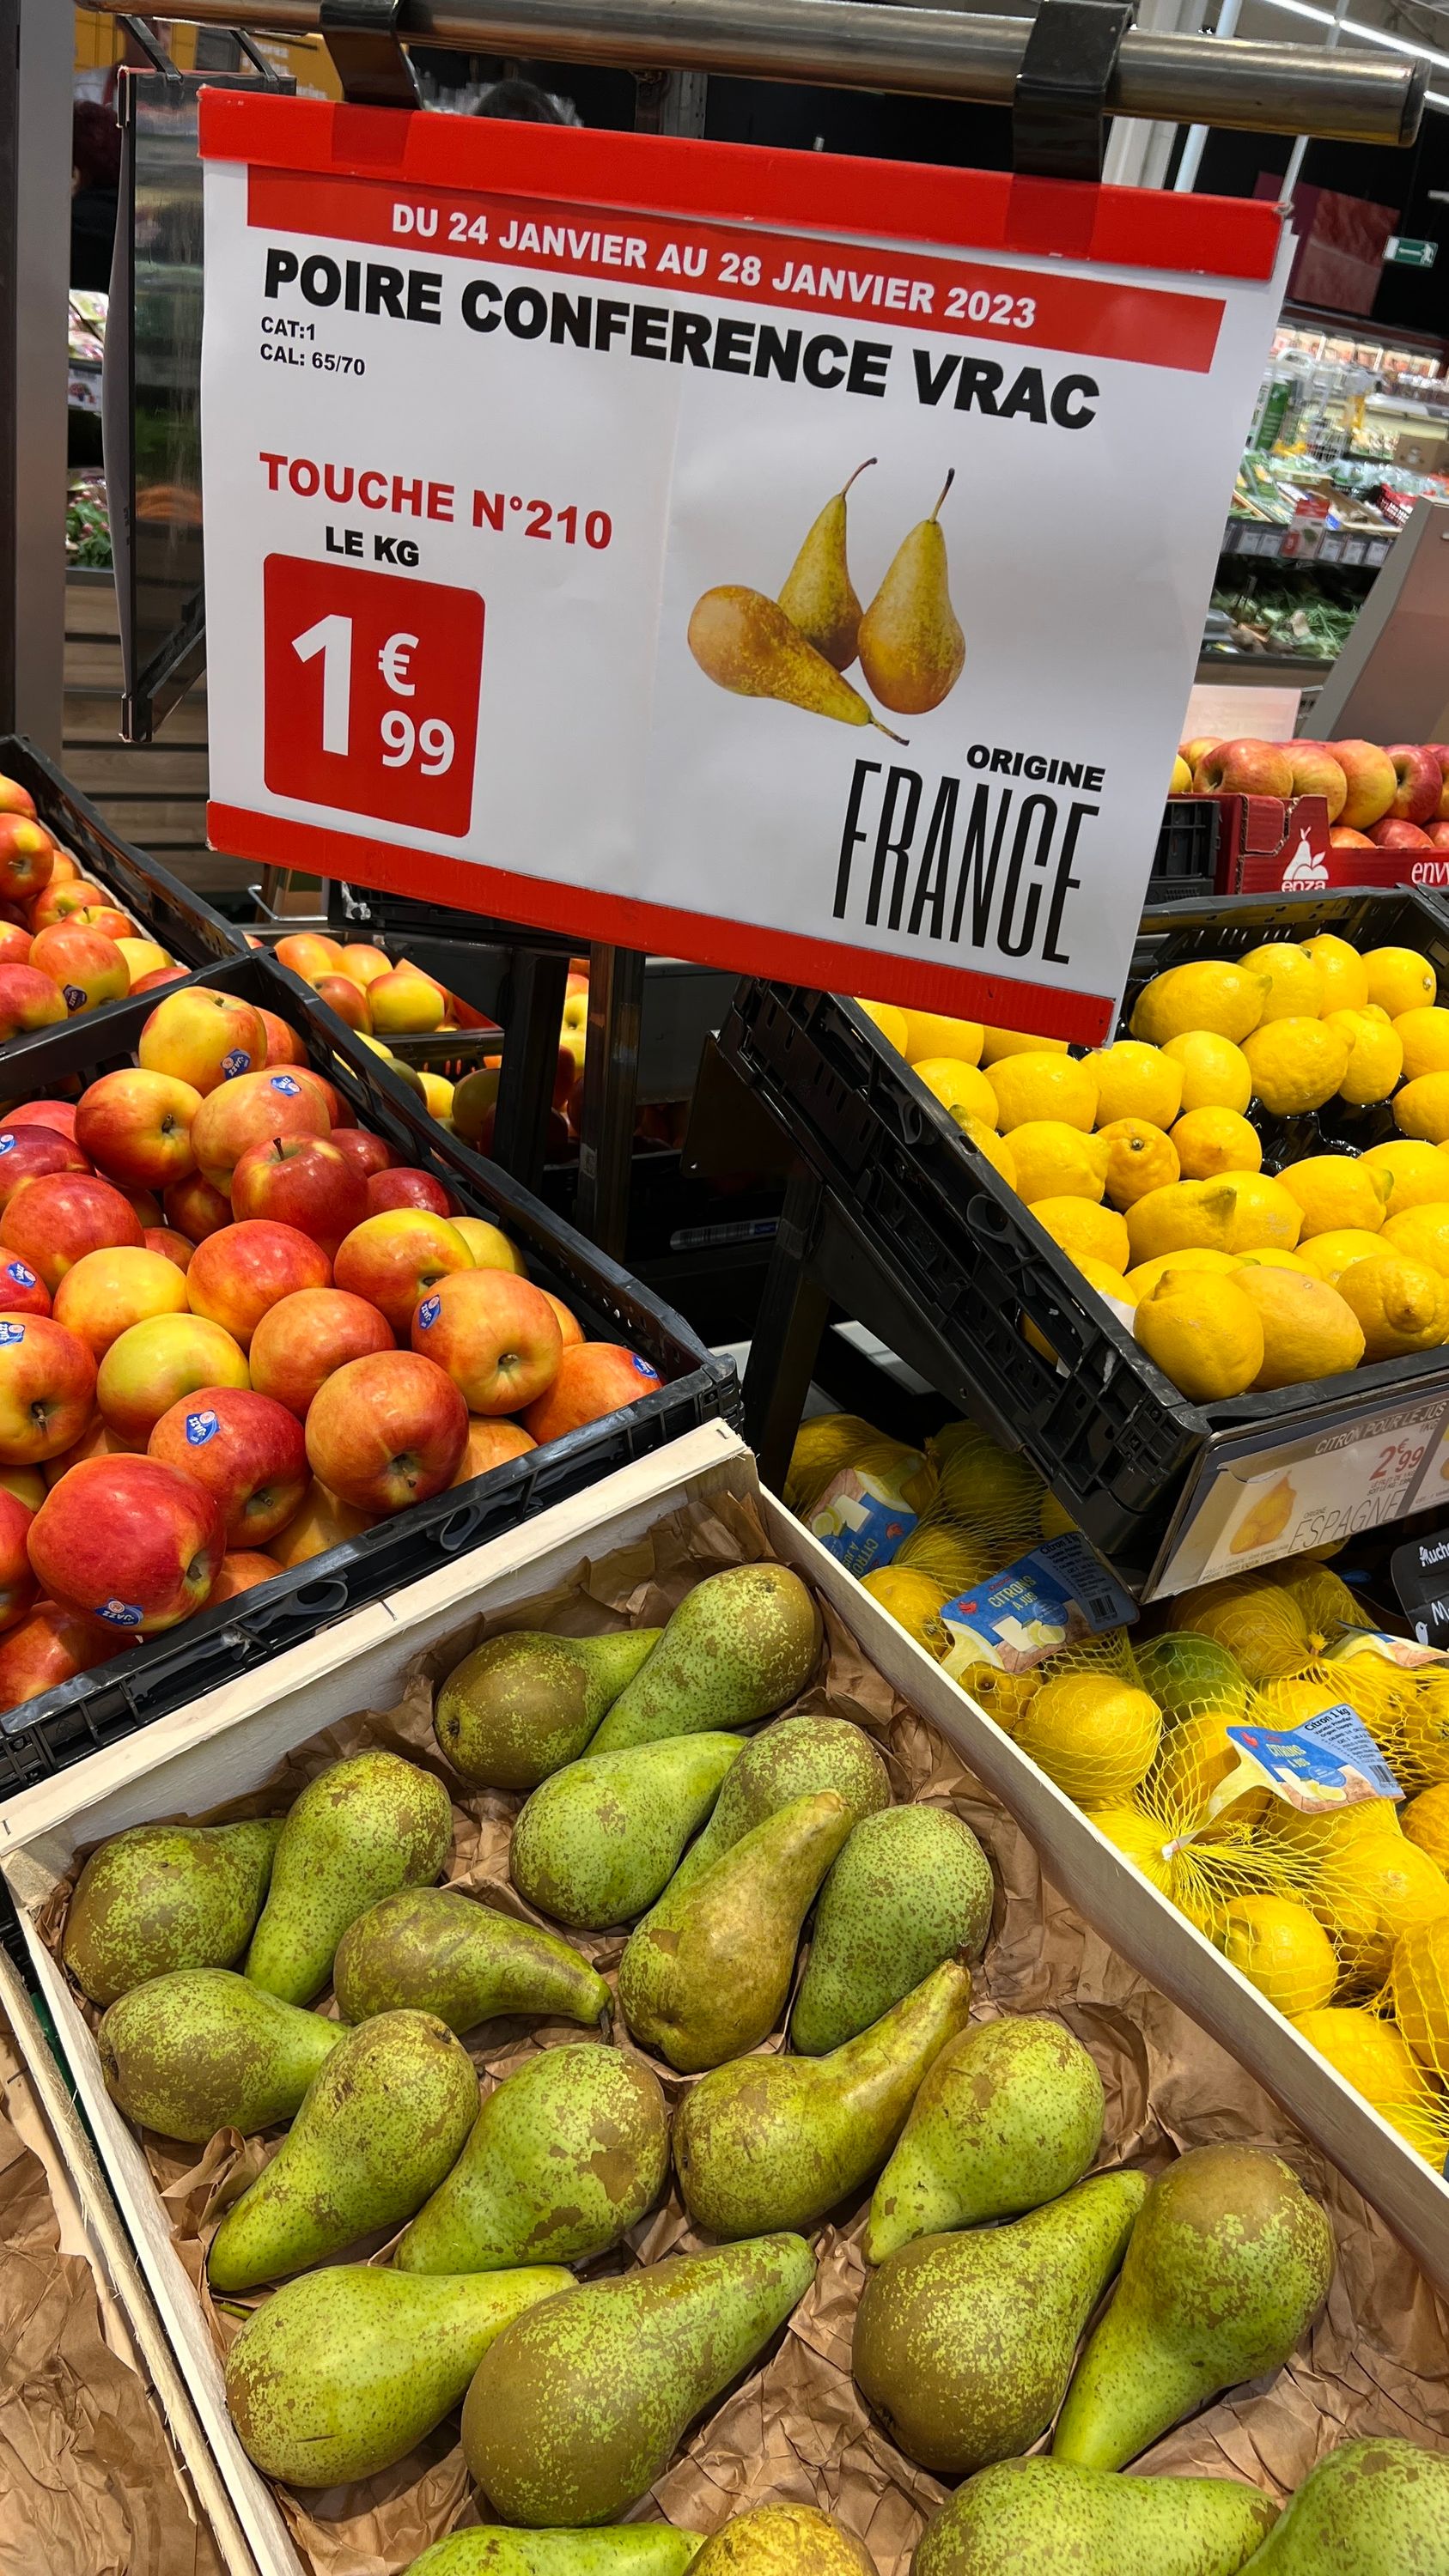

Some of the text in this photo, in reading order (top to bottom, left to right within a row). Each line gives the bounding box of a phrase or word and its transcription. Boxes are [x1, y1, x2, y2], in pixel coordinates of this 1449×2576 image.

[393, 203, 1037, 329] DU 24 JANVIER AU 28 JANVIER 2023
[260, 316, 315, 342] CAT:1
[265, 248, 1099, 429] POIRE CONFERENCE VRAC
[259, 343, 366, 376] CAL: 65/70
[259, 452, 612, 550] TOUCHE N°210
[326, 526, 419, 567] LE KG
[291, 614, 352, 756] 1
[380, 710, 455, 775] 99
[966, 744, 1105, 793] ORIGINE
[832, 758, 1099, 965] FRANCE
[1281, 880, 1326, 893] enza
[1315, 1401, 1447, 1455] CITRON POUR LE JUS
[1288, 1489, 1407, 1553] ESPAGNE
[987, 1575, 1038, 1608] CITRONS
[1304, 1716, 1333, 1731] Citron
